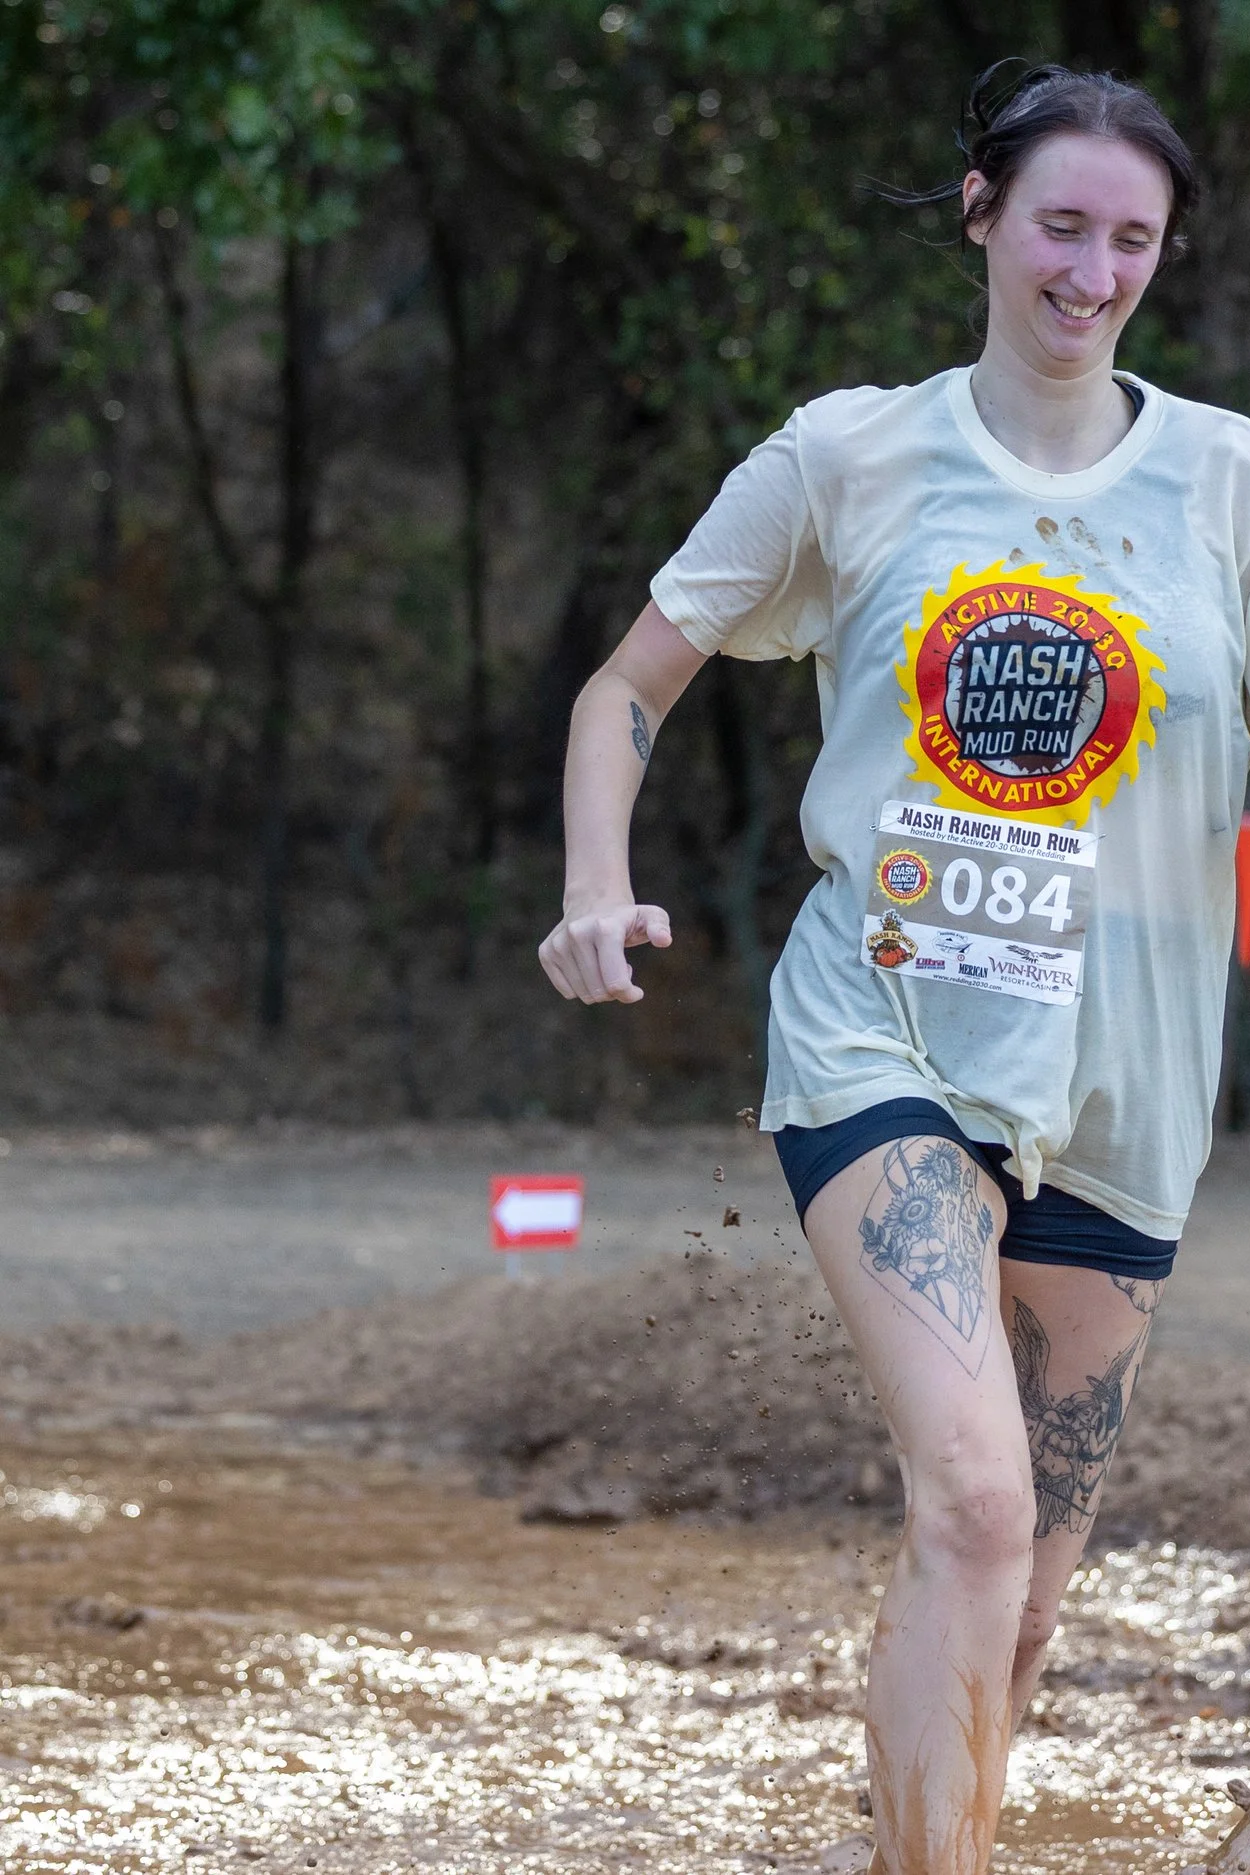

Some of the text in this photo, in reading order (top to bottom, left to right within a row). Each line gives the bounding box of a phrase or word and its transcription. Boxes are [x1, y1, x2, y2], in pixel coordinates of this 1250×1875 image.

[940, 591, 1127, 670] ACTIVE 20-30
[968, 645, 1086, 686] NASH
[962, 690, 1077, 724] RANCH
[925, 714, 1115, 803] INTERNATIONAL
[964, 729, 1069, 755] MUD RUN
[901, 807, 1080, 854] NASH RANCH MUD RUN
[910, 827, 935, 839] hosted
[948, 834, 959, 843] the
[960, 837, 984, 847] Active
[985, 840, 1008, 851] 20-30
[1010, 845, 1026, 854] Club
[1028, 847, 1035, 856] of
[1036, 850, 1066, 861] Redding
[893, 866, 917, 875] NASH
[941, 858, 1073, 932] 084
[870, 932, 915, 949] NASH RANCH
[933, 974, 1002, 991] www.redding2030.com
[1000, 975, 1025, 986] RESORT
